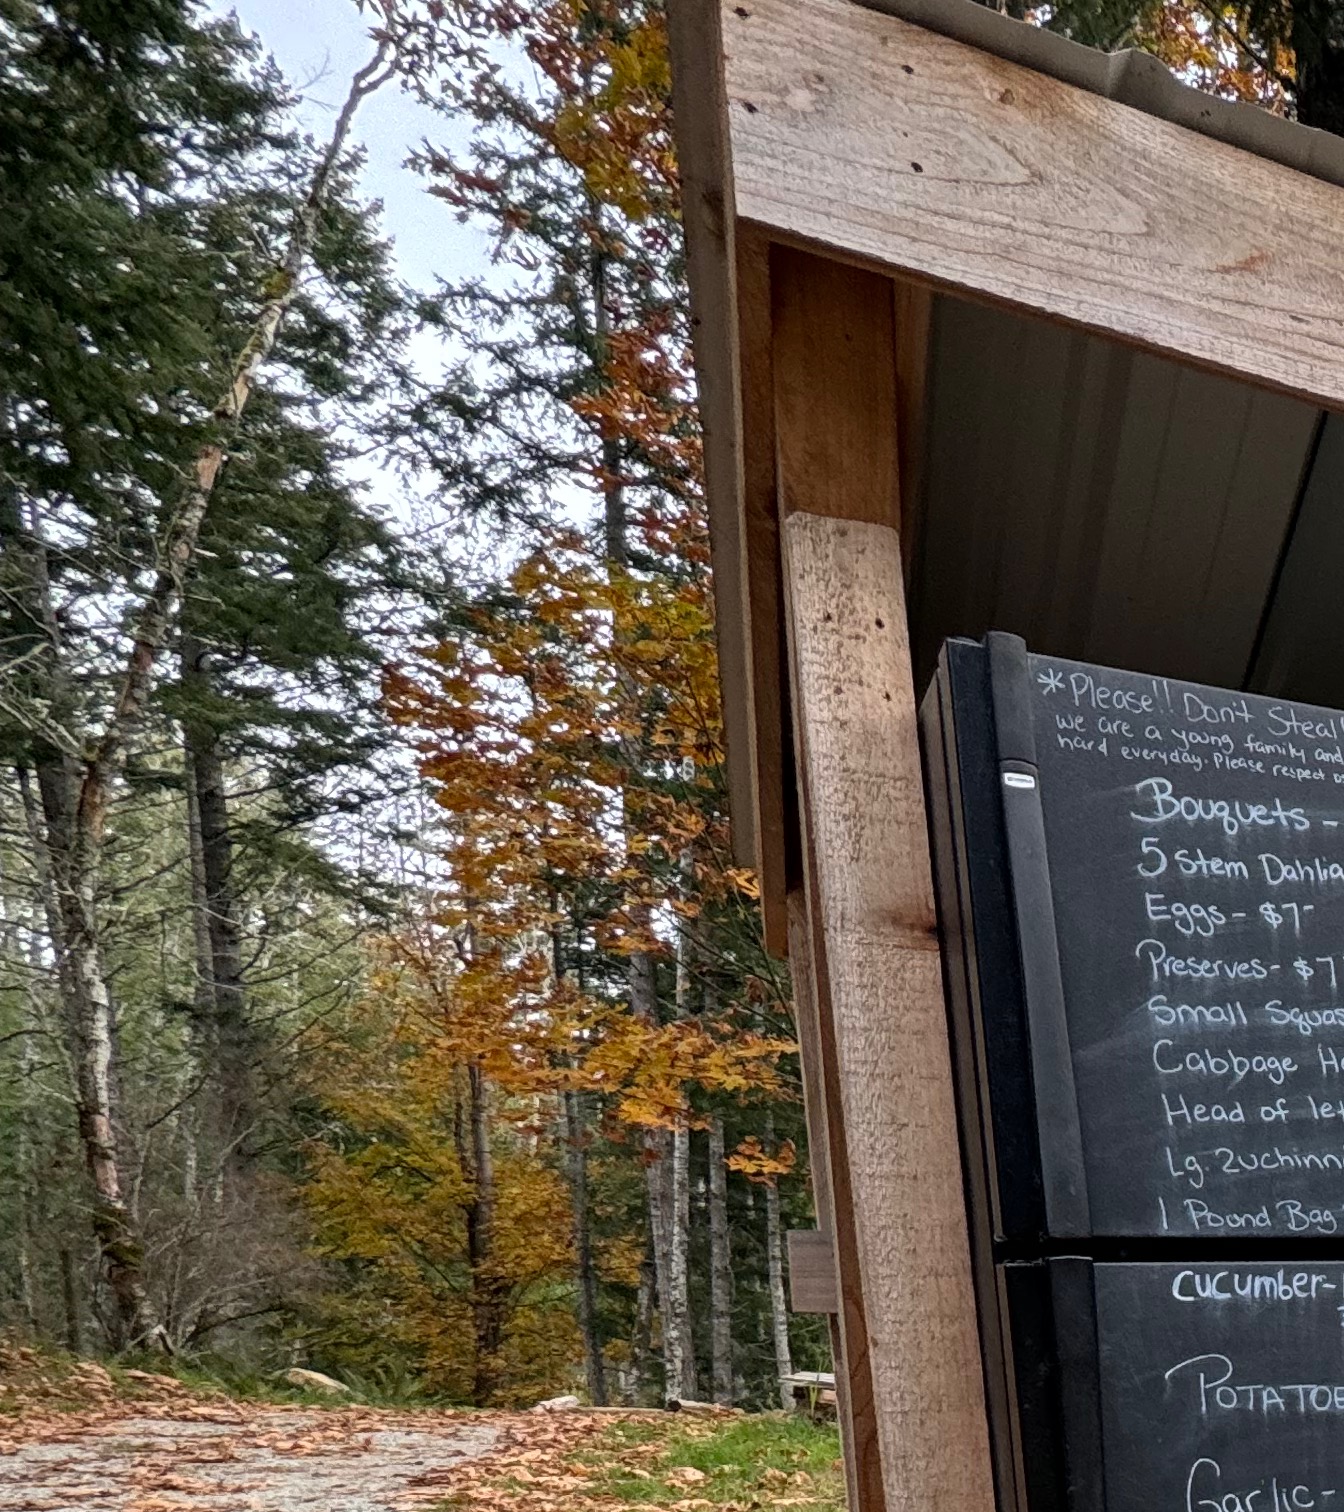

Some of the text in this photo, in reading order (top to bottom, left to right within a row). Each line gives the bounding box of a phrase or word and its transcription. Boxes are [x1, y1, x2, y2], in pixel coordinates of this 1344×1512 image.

[1184, 692, 1255, 723] Don't
[1057, 733, 1108, 757] hard
[1214, 754, 1265, 774] Please
[1272, 762, 1326, 781] respect
[1098, 715, 1134, 738] are
[1145, 726, 1163, 741] a
[1171, 730, 1234, 757] young
[1244, 735, 1306, 764] family
[1314, 745, 1344, 765] and
[1130, 776, 1310, 836] Bouquets
[1137, 837, 1168, 877] 5
[1147, 994, 1248, 1026] Small
[1152, 1039, 1299, 1088] Cabbage
[1160, 1093, 1246, 1128] Head
[1259, 1098, 1291, 1122] of
[1183, 1199, 1272, 1232] Pound
[1275, 1200, 1338, 1234] Bag
